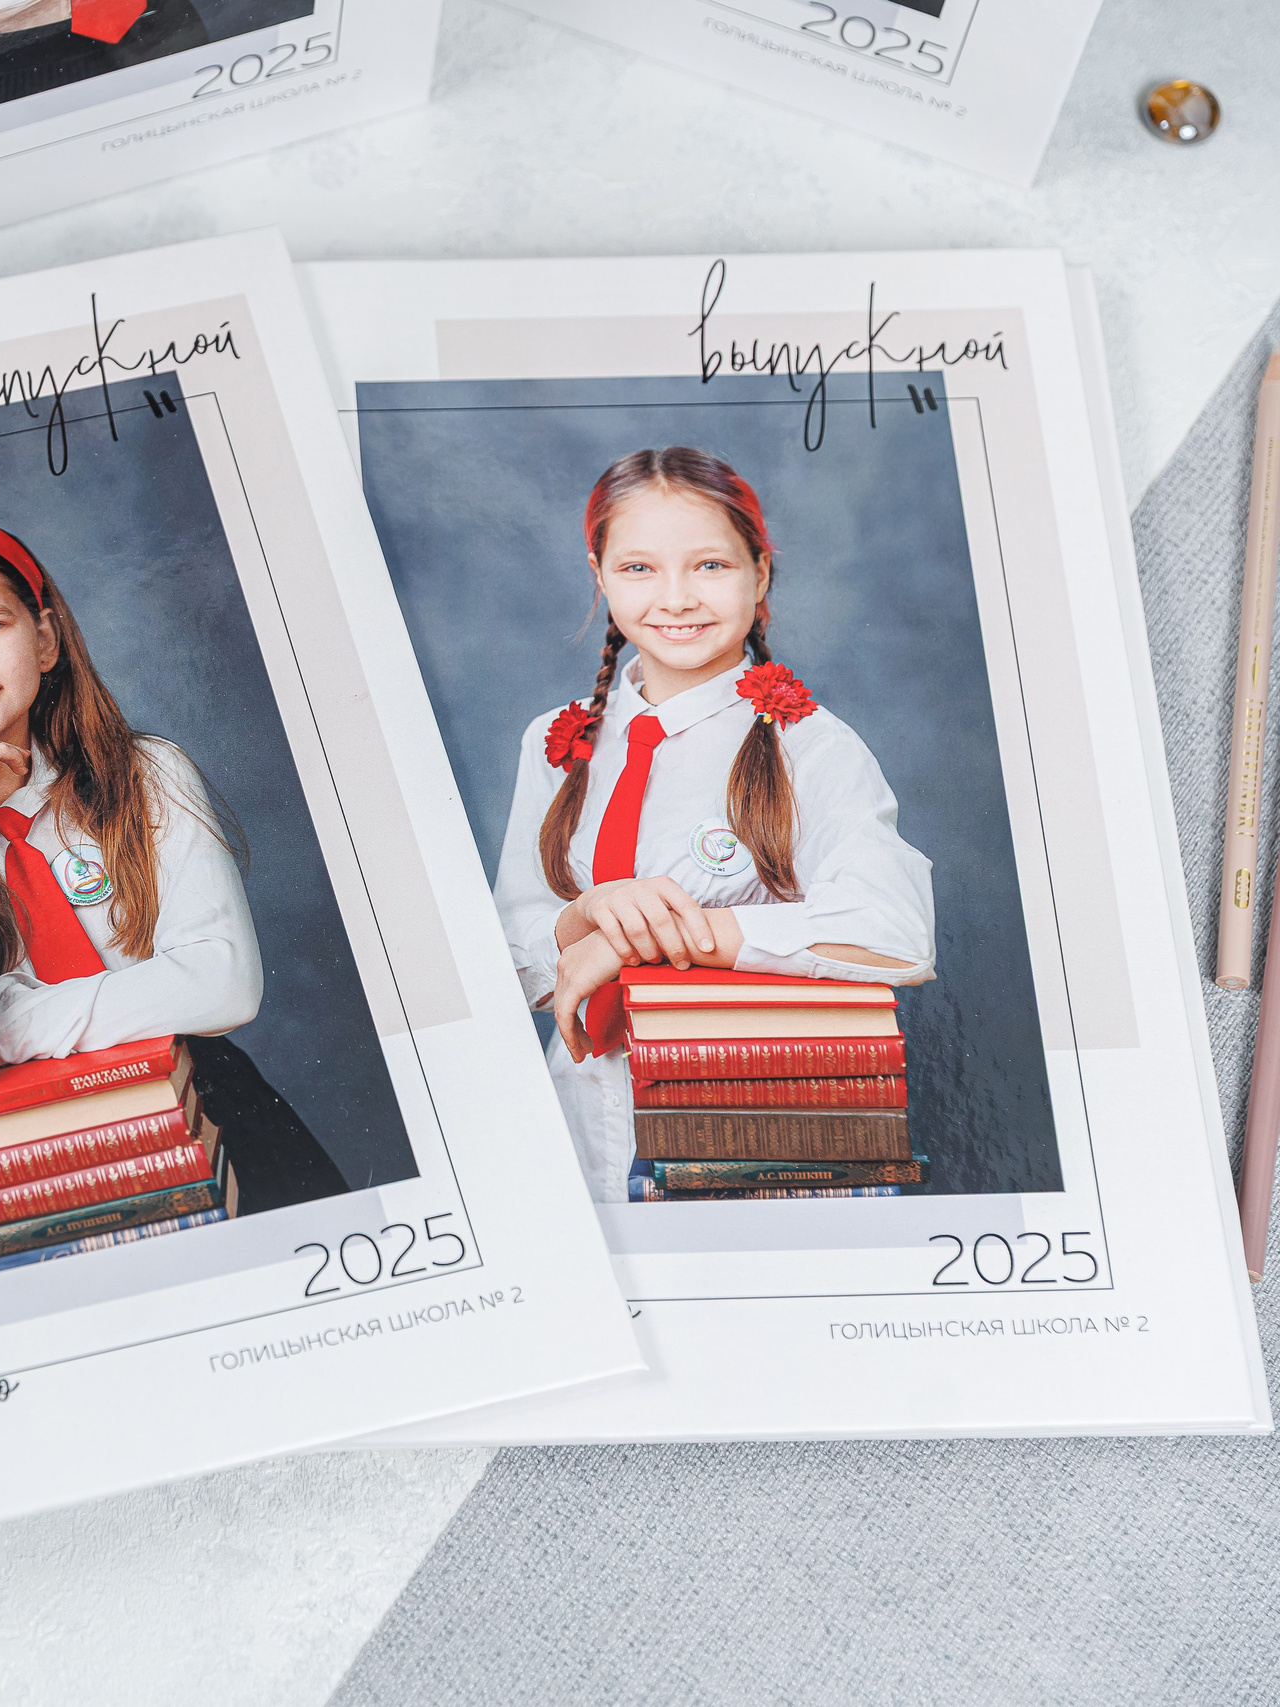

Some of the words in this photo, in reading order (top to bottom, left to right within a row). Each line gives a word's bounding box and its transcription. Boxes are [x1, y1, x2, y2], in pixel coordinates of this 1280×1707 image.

[191, 31, 333, 99] 2025
[702, 16, 849, 78] ГОЛИЦЫНСКАЯ
[851, 69, 925, 104] ШКОЛА
[800, 0, 950, 75] 2025
[100, 102, 246, 153] ГОЛИЦЫНСКАЯ
[249, 82, 321, 112] ШКОЛА
[294, 1212, 466, 1298] 2025
[928, 1231, 1099, 1287] 2025
[208, 1319, 384, 1374] ГОЛИЦЫНСКАЯ
[388, 1298, 475, 1333] ШКОЛА
[479, 1289, 505, 1310] №
[510, 1286, 525, 1305] 2
[829, 1318, 1005, 1341] ГОЛИЦЫНСКАЯ
[1011, 1316, 1099, 1337] ШКОЛА
[1104, 1316, 1131, 1333] №
[1137, 1315, 1151, 1333] 2
